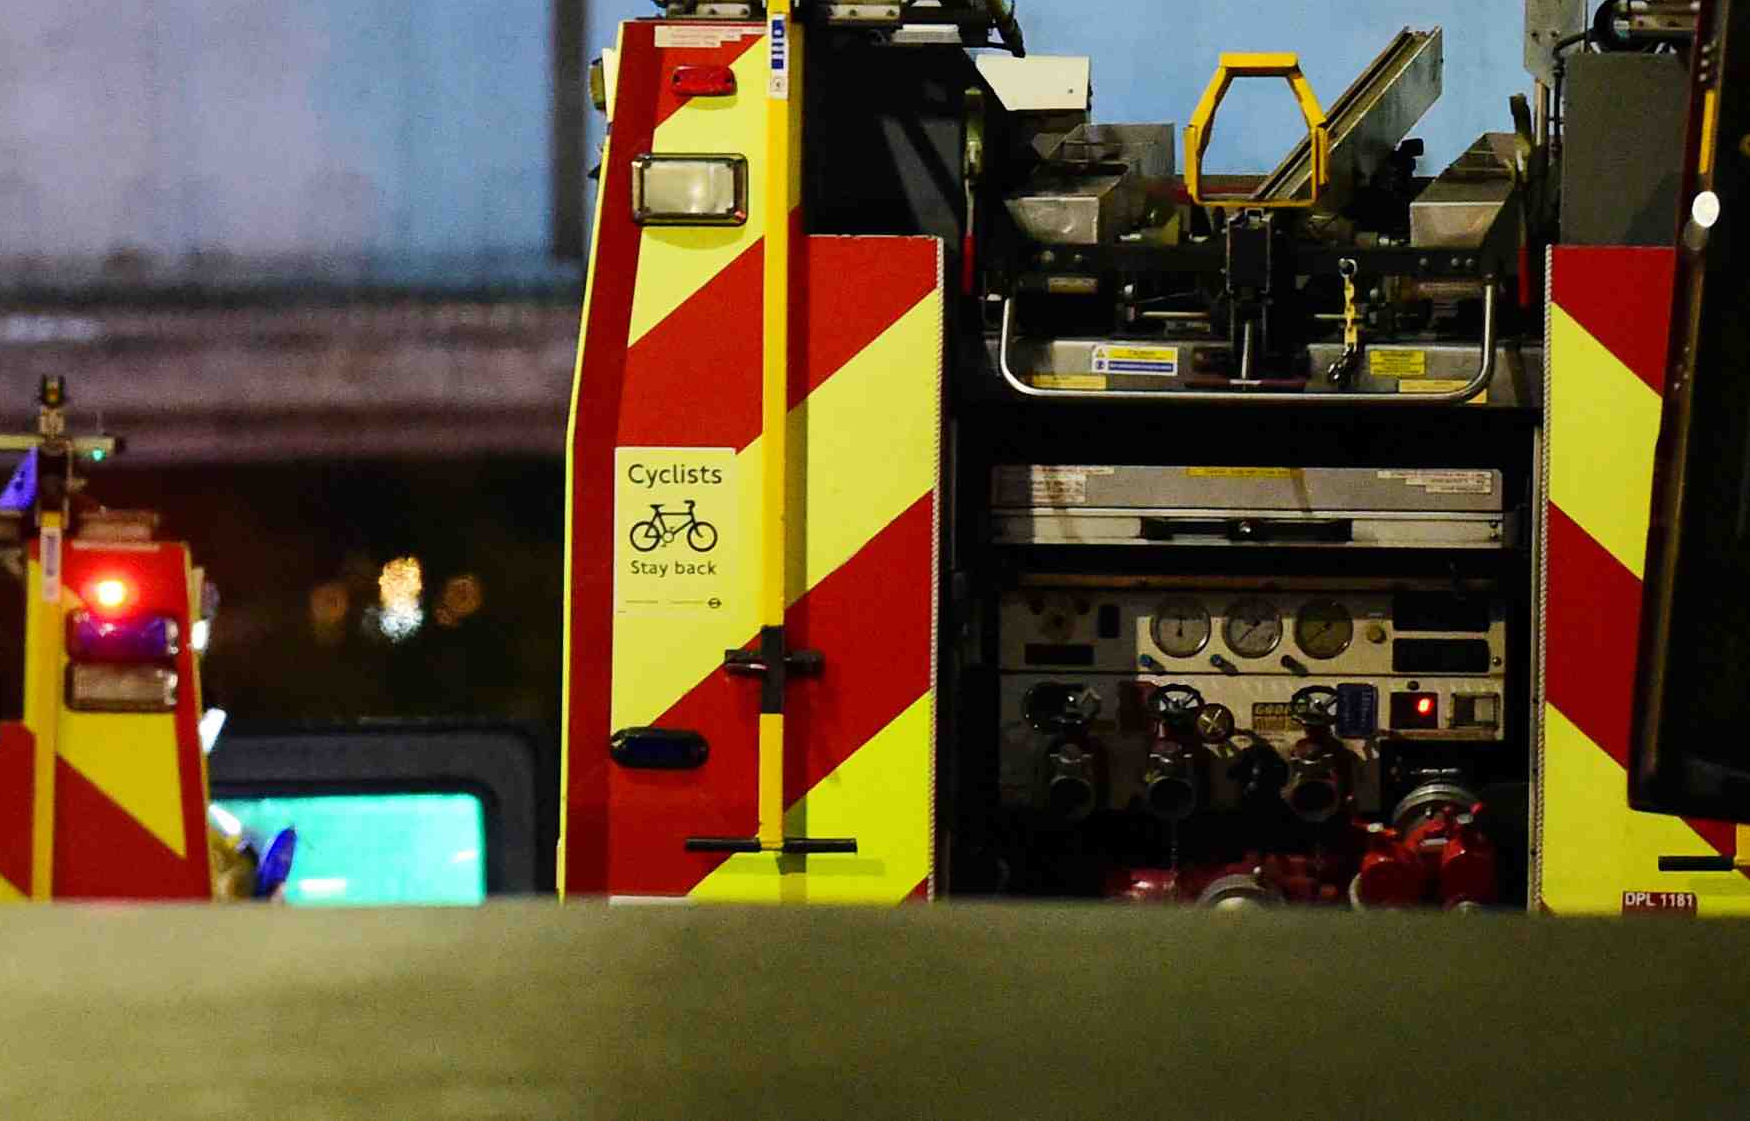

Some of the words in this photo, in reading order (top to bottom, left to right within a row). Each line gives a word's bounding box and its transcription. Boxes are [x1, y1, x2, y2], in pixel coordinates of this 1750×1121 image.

[627, 463, 723, 489] Cyclists
[630, 560, 669, 577] Stay
[675, 561, 717, 575] back
[1625, 892, 1656, 907] DPL
[1659, 893, 1694, 908] 1181
